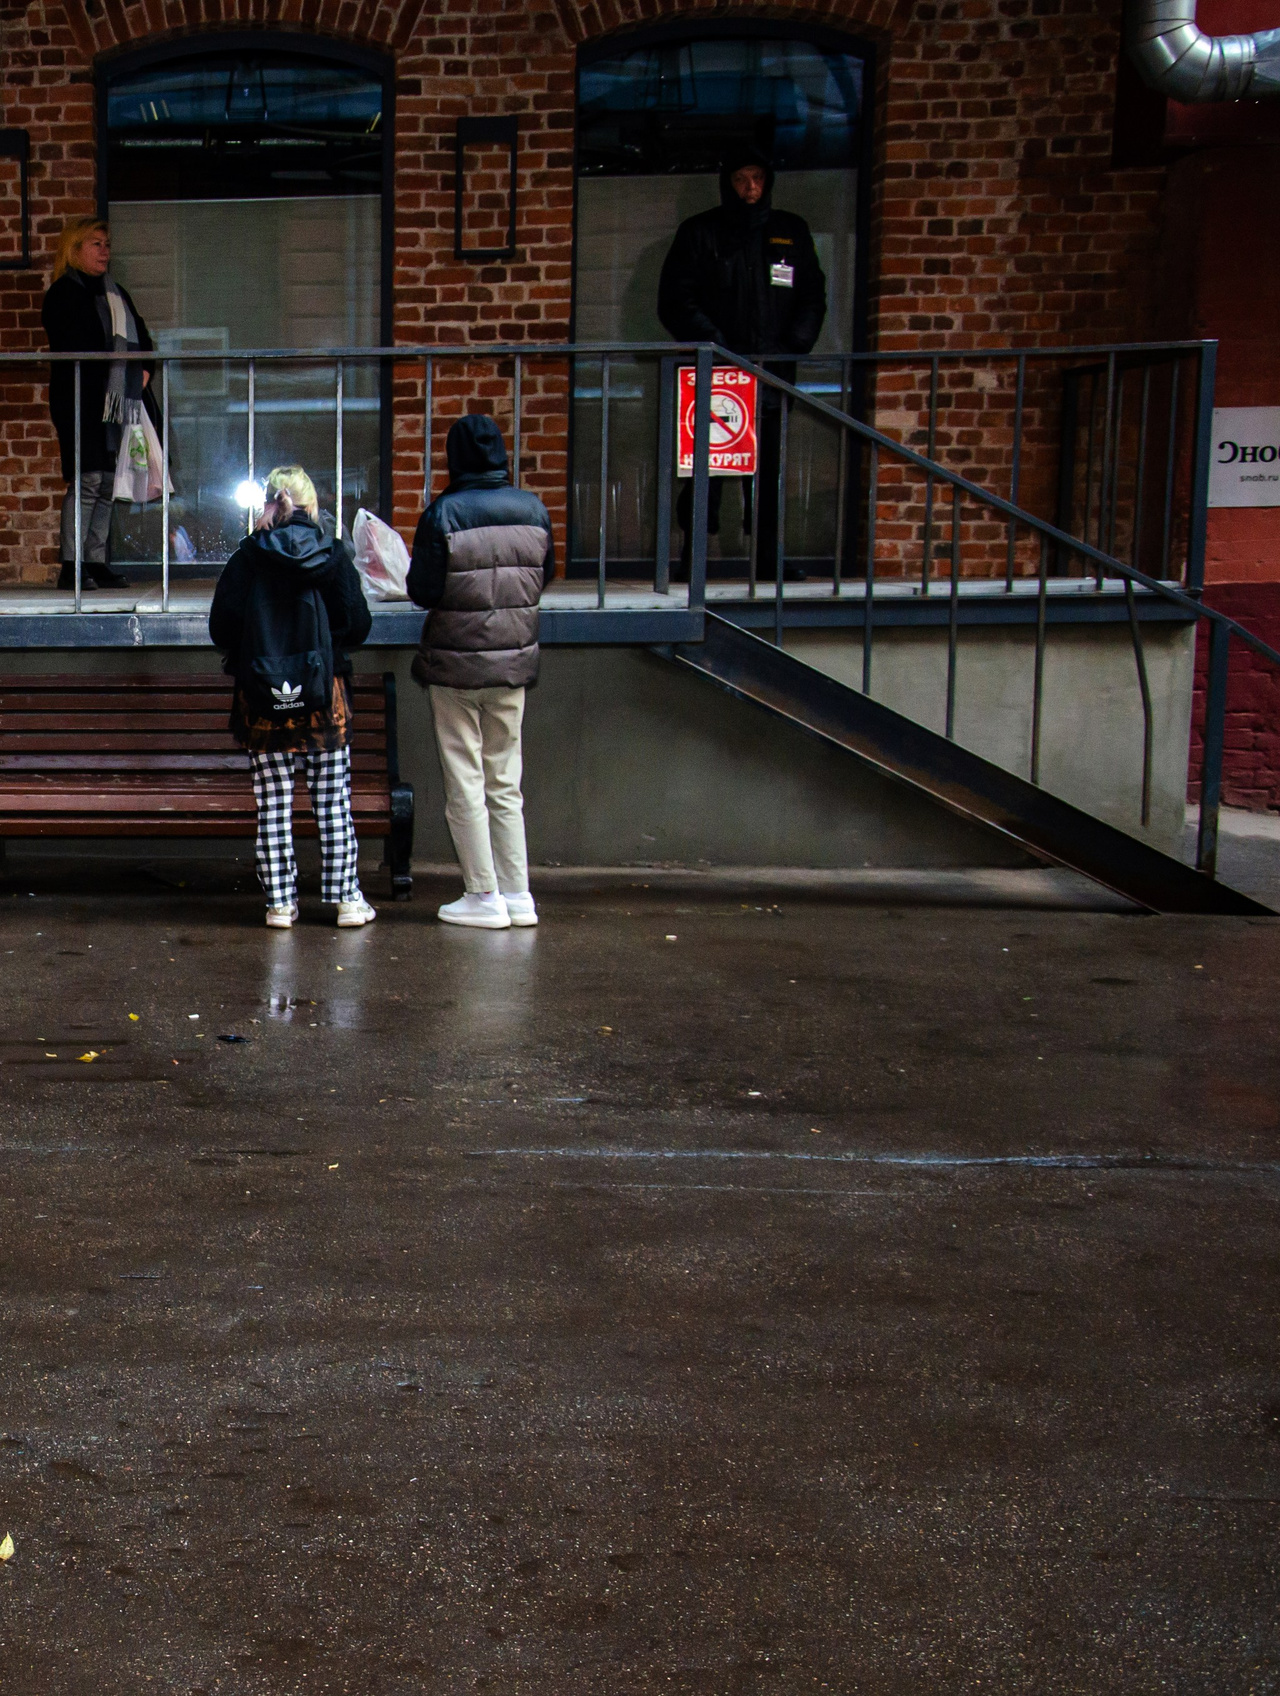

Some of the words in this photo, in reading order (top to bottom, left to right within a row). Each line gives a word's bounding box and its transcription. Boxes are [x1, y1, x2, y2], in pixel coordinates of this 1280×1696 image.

[687, 371, 750, 386] ЗЕСЬ
[1240, 474, 1279, 482] snob.ru
[273, 701, 304, 709] adidas
